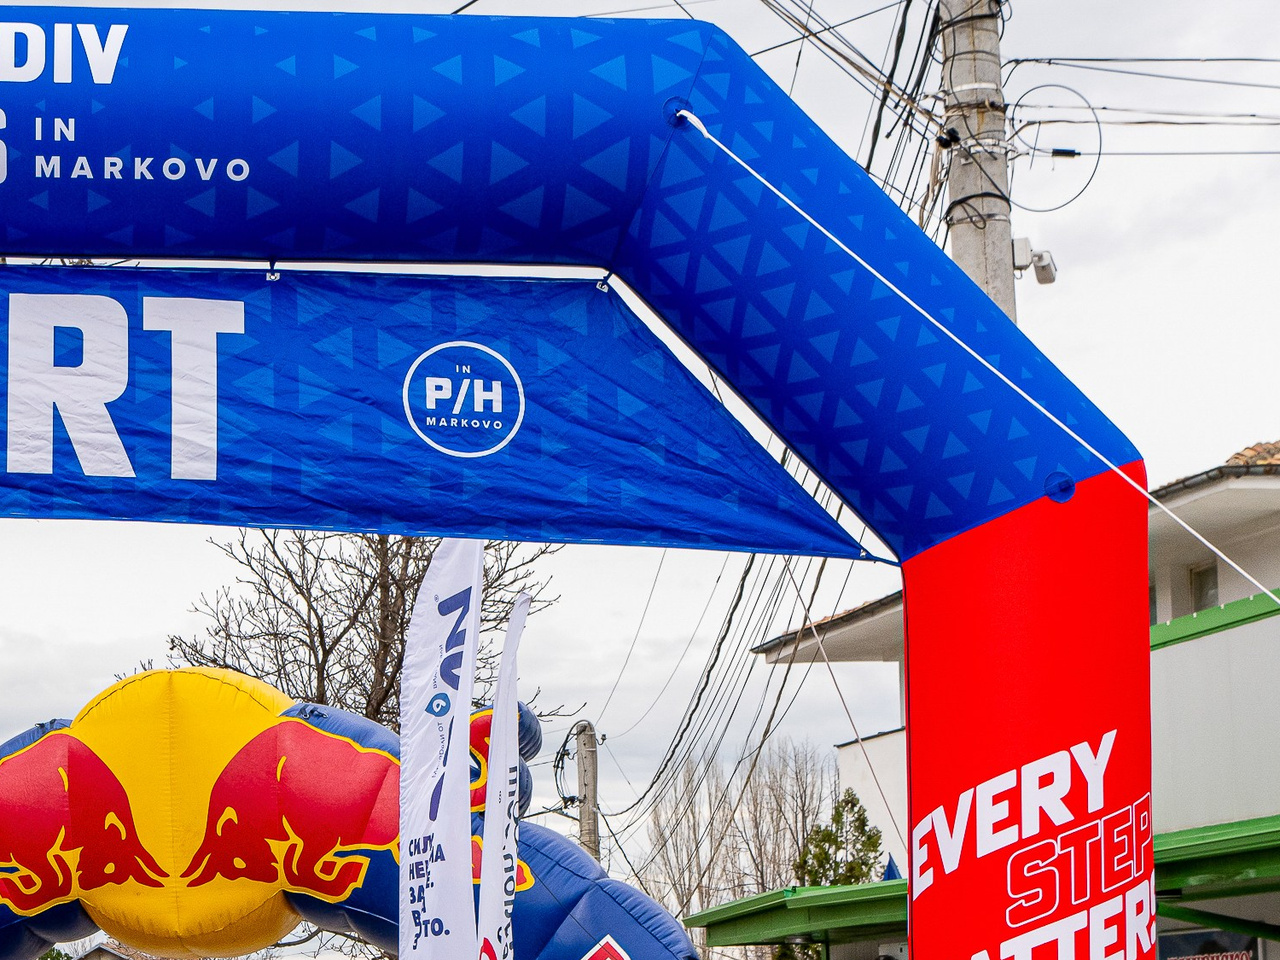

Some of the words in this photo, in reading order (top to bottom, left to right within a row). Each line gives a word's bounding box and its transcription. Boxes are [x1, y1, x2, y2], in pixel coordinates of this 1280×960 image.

[34, 118, 76, 142] IN
[34, 155, 252, 182] MARKOVO
[455, 365, 471, 374] IN
[425, 377, 503, 415] P/H
[426, 417, 503, 430] MARKOVO
[912, 729, 1117, 902] EVERY
[1006, 792, 1151, 928] STEP
